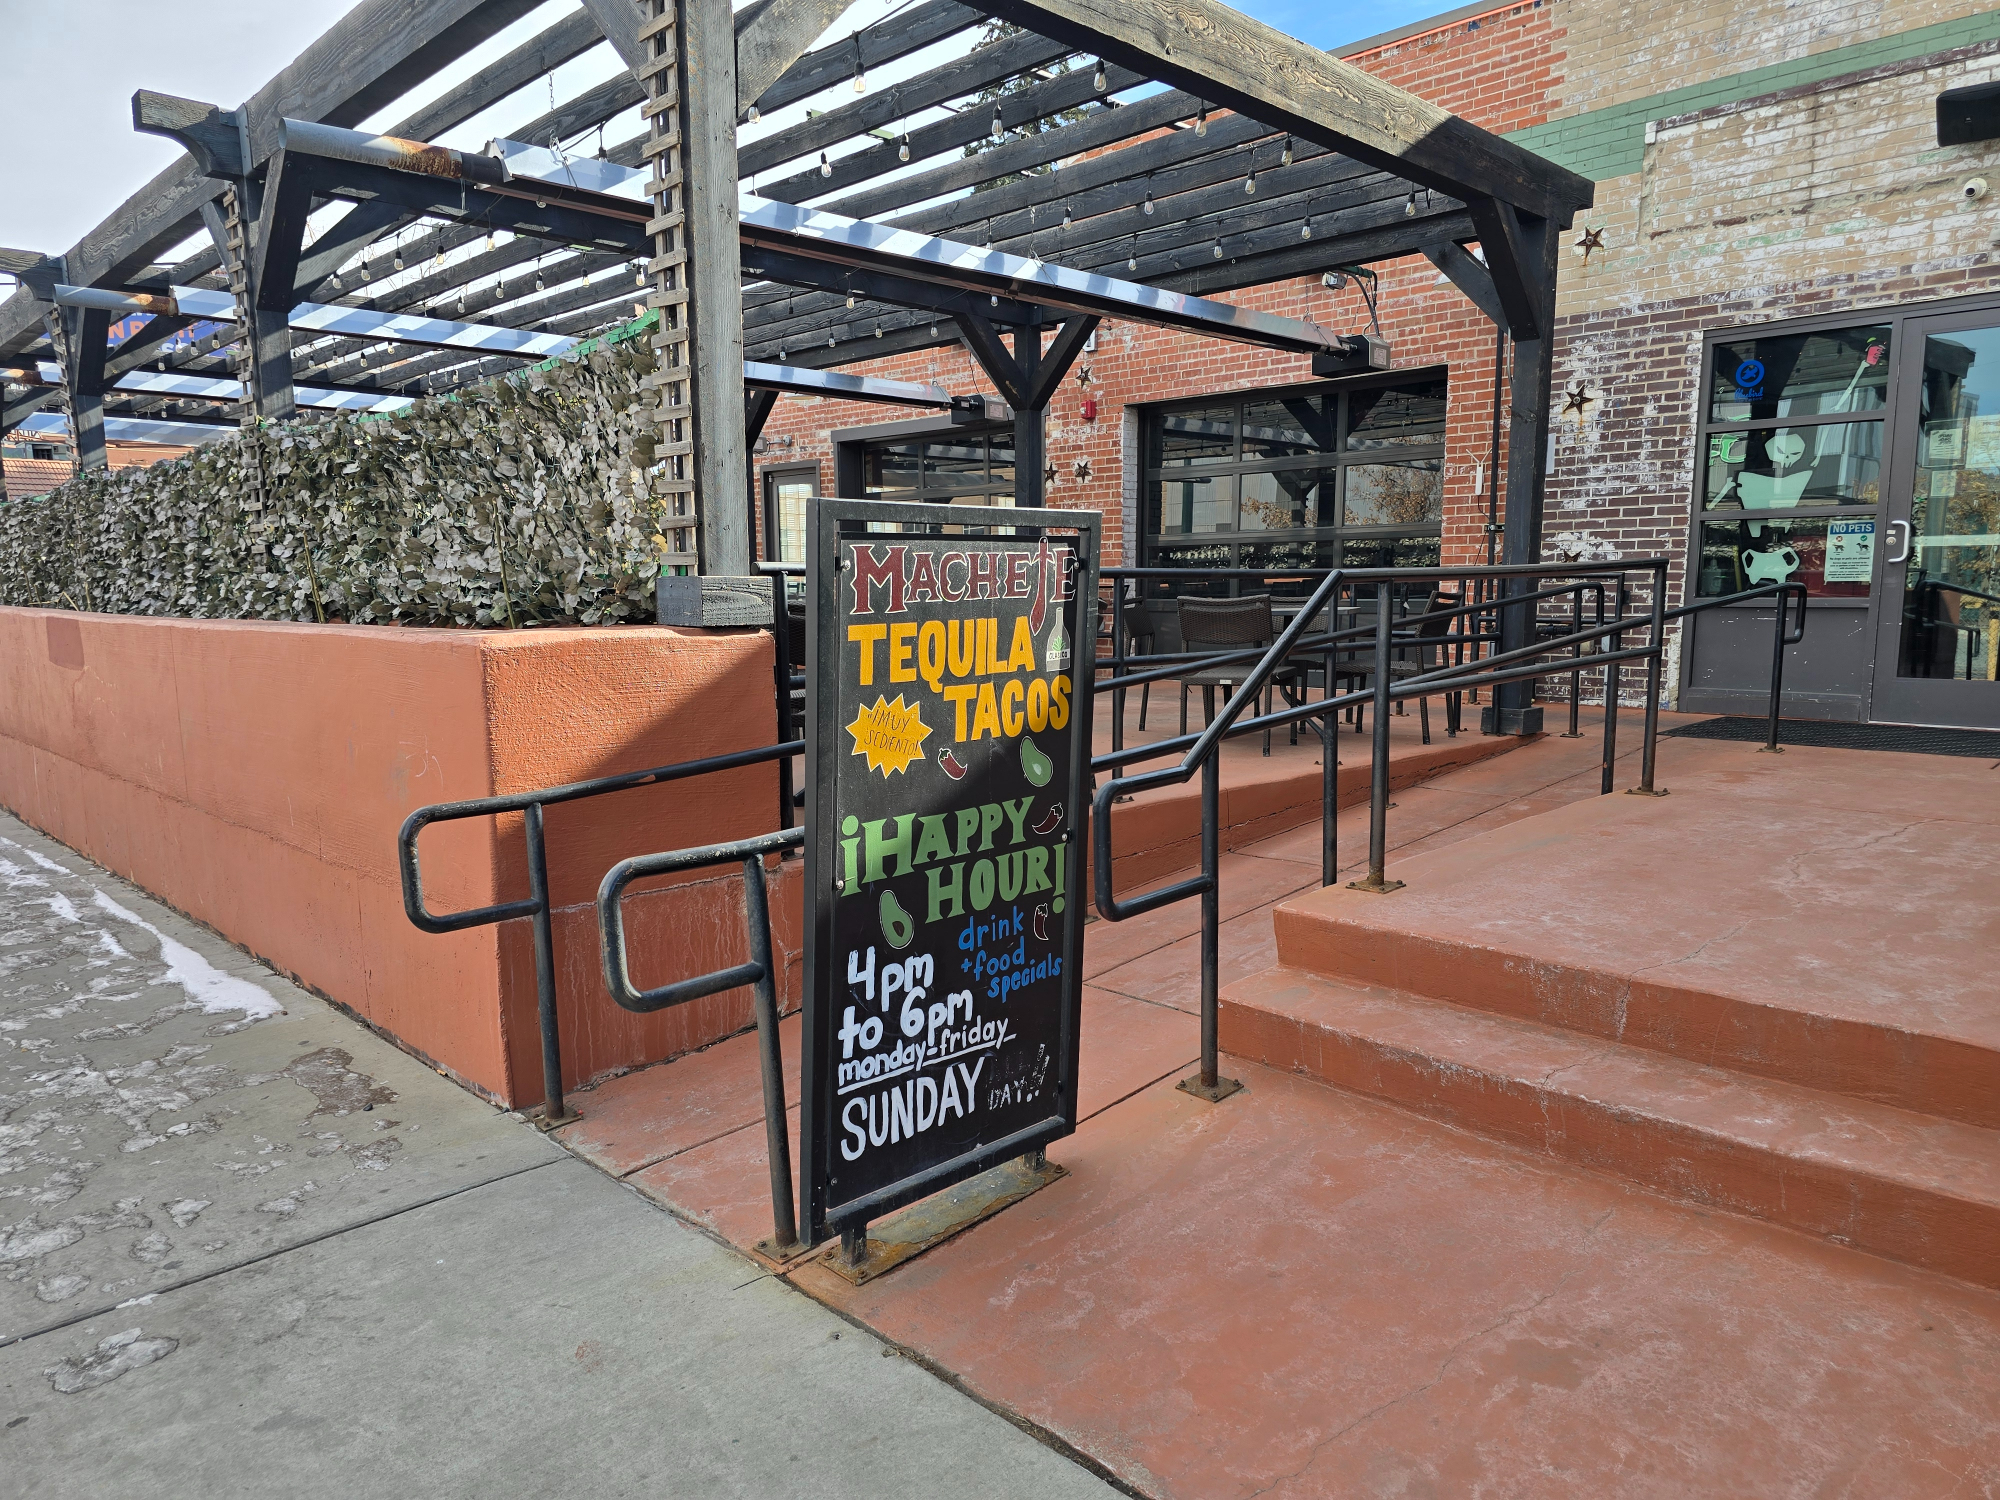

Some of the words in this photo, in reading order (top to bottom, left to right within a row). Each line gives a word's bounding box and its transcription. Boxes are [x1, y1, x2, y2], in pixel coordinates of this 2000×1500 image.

[1832, 524, 1847, 533] NO
[1848, 523, 1872, 533] PETS
[850, 537, 1077, 636] MACHETE
[847, 616, 1036, 694] TEQUILA
[943, 674, 1072, 743] TACOS
[924, 843, 1066, 924] HOUR!
[958, 905, 1024, 952] drink
[987, 957, 1063, 1003] specials
[838, 1005, 884, 1059] to
[840, 1056, 986, 1162] SUNDAY
